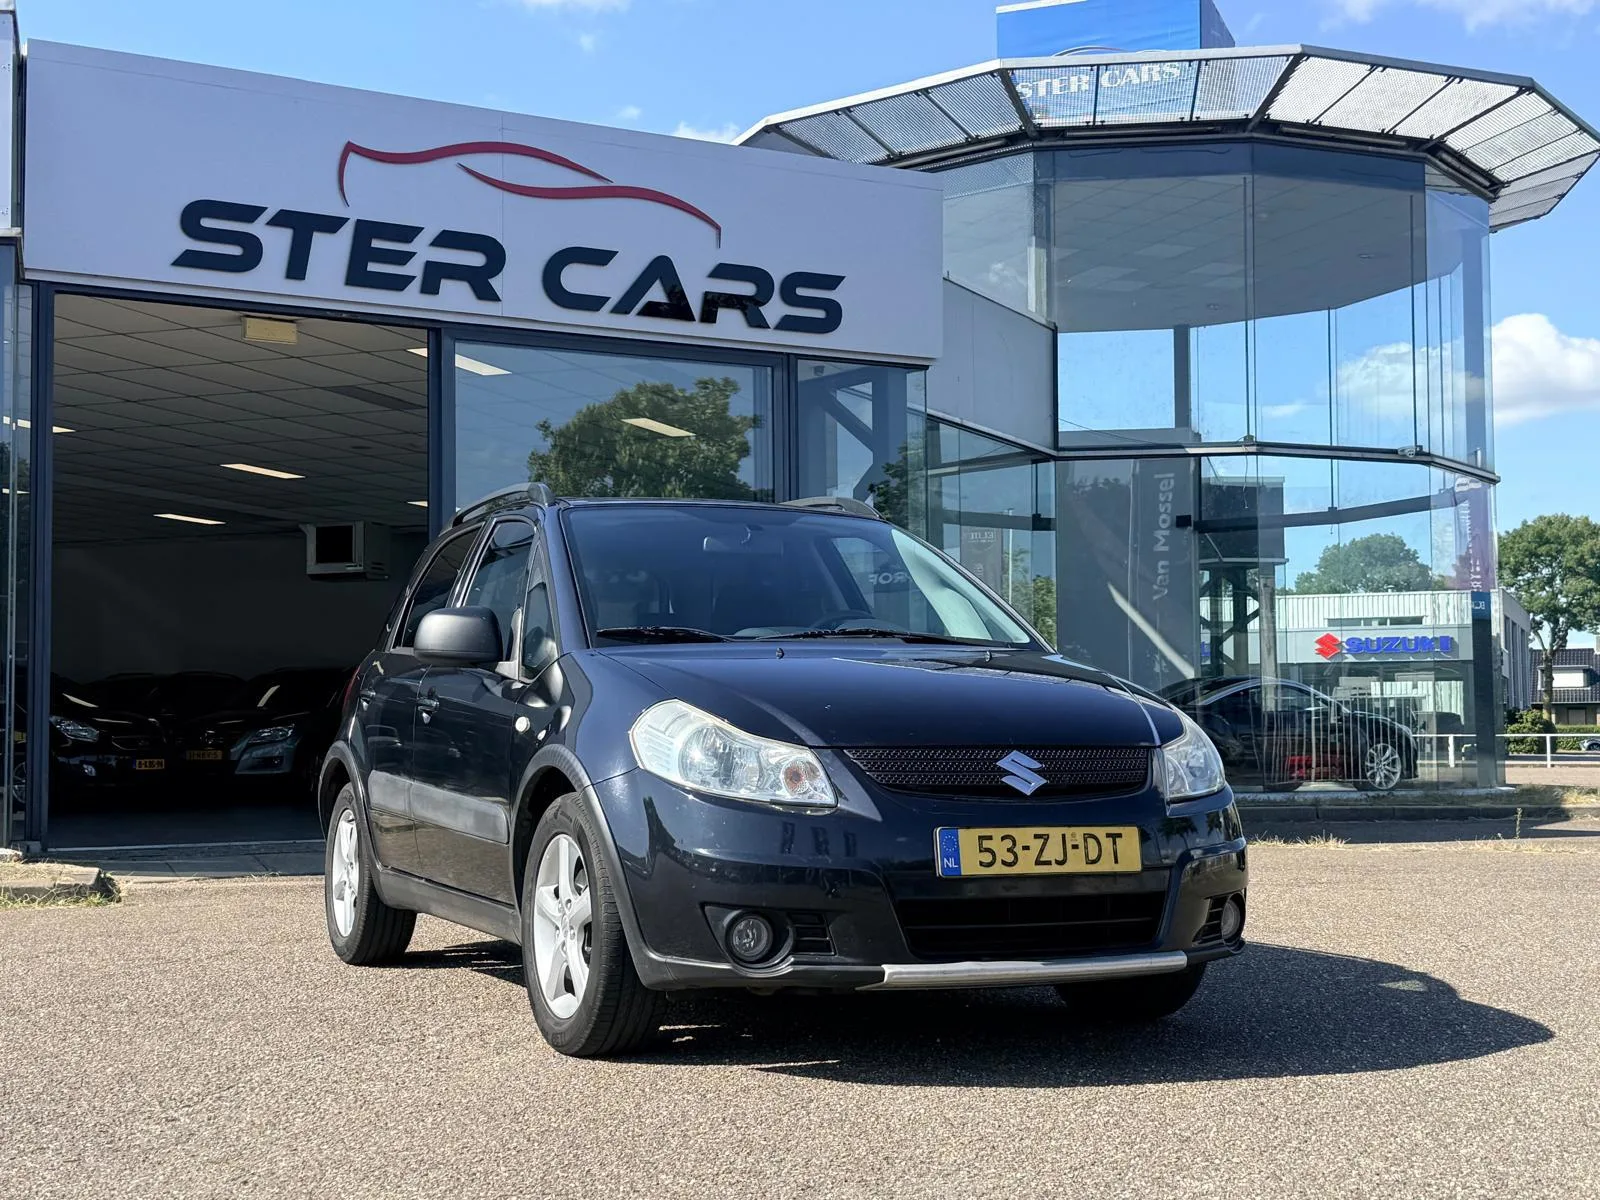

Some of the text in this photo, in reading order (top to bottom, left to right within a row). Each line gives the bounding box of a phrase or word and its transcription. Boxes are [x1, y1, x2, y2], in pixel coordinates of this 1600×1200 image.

[1015, 63, 1181, 99] STER CARS
[171, 200, 846, 335] STER CARS
[1153, 473, 1175, 600] Van Mossel
[1344, 635, 1452, 655] SUZUKI
[943, 857, 959, 868] NL
[977, 832, 1123, 868] 53-ZJ-DT
